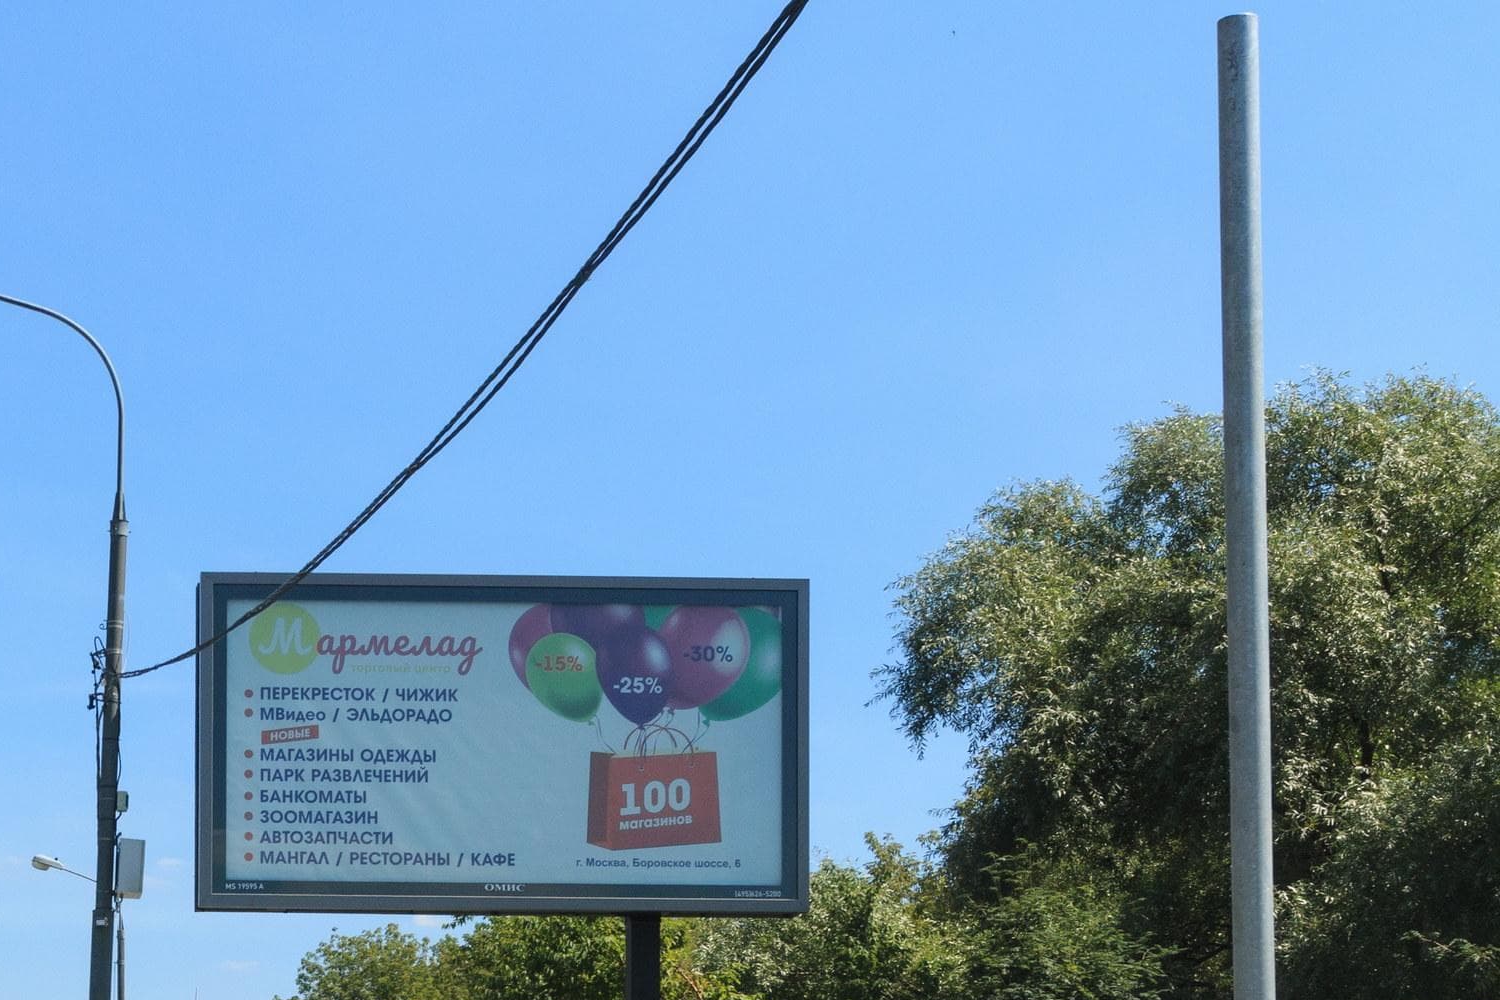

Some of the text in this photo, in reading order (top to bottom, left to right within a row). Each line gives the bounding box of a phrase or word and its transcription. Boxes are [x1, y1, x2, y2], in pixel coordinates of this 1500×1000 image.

[258, 616, 483, 675] Мармелад
[683, 646, 733, 663] -30%
[535, 656, 583, 672] -15%
[613, 677, 663, 694] -25%
[260, 687, 459, 703] ПЕРЕКРЕСТОК / ЧИЖИК
[260, 707, 452, 724] МВидео / ЭЛЬДОРАДО
[269, 726, 312, 742] НОВЫЕ
[260, 748, 436, 766] МАГАЗИНЫ ОДЕЖДЫ
[260, 766, 429, 784] ПАРК РАЗВЛЕЧЕНИЙ
[260, 790, 367, 804] БАНКОМАТЫ
[620, 778, 692, 816] 100
[260, 810, 379, 825] ЗООМАГАЗИН
[619, 815, 693, 831] магазинов
[260, 831, 393, 845] АВТОЗАПЧАСТИ
[260, 851, 516, 867] МАНГАЛ / РЕСТОРАНЫ / КАФЕ
[586, 858, 629, 868] Москва,
[632, 858, 691, 870] Боровское
[694, 860, 732, 869] шоссе,
[734, 859, 741, 868] 6
[484, 883, 525, 892] ОМИС
